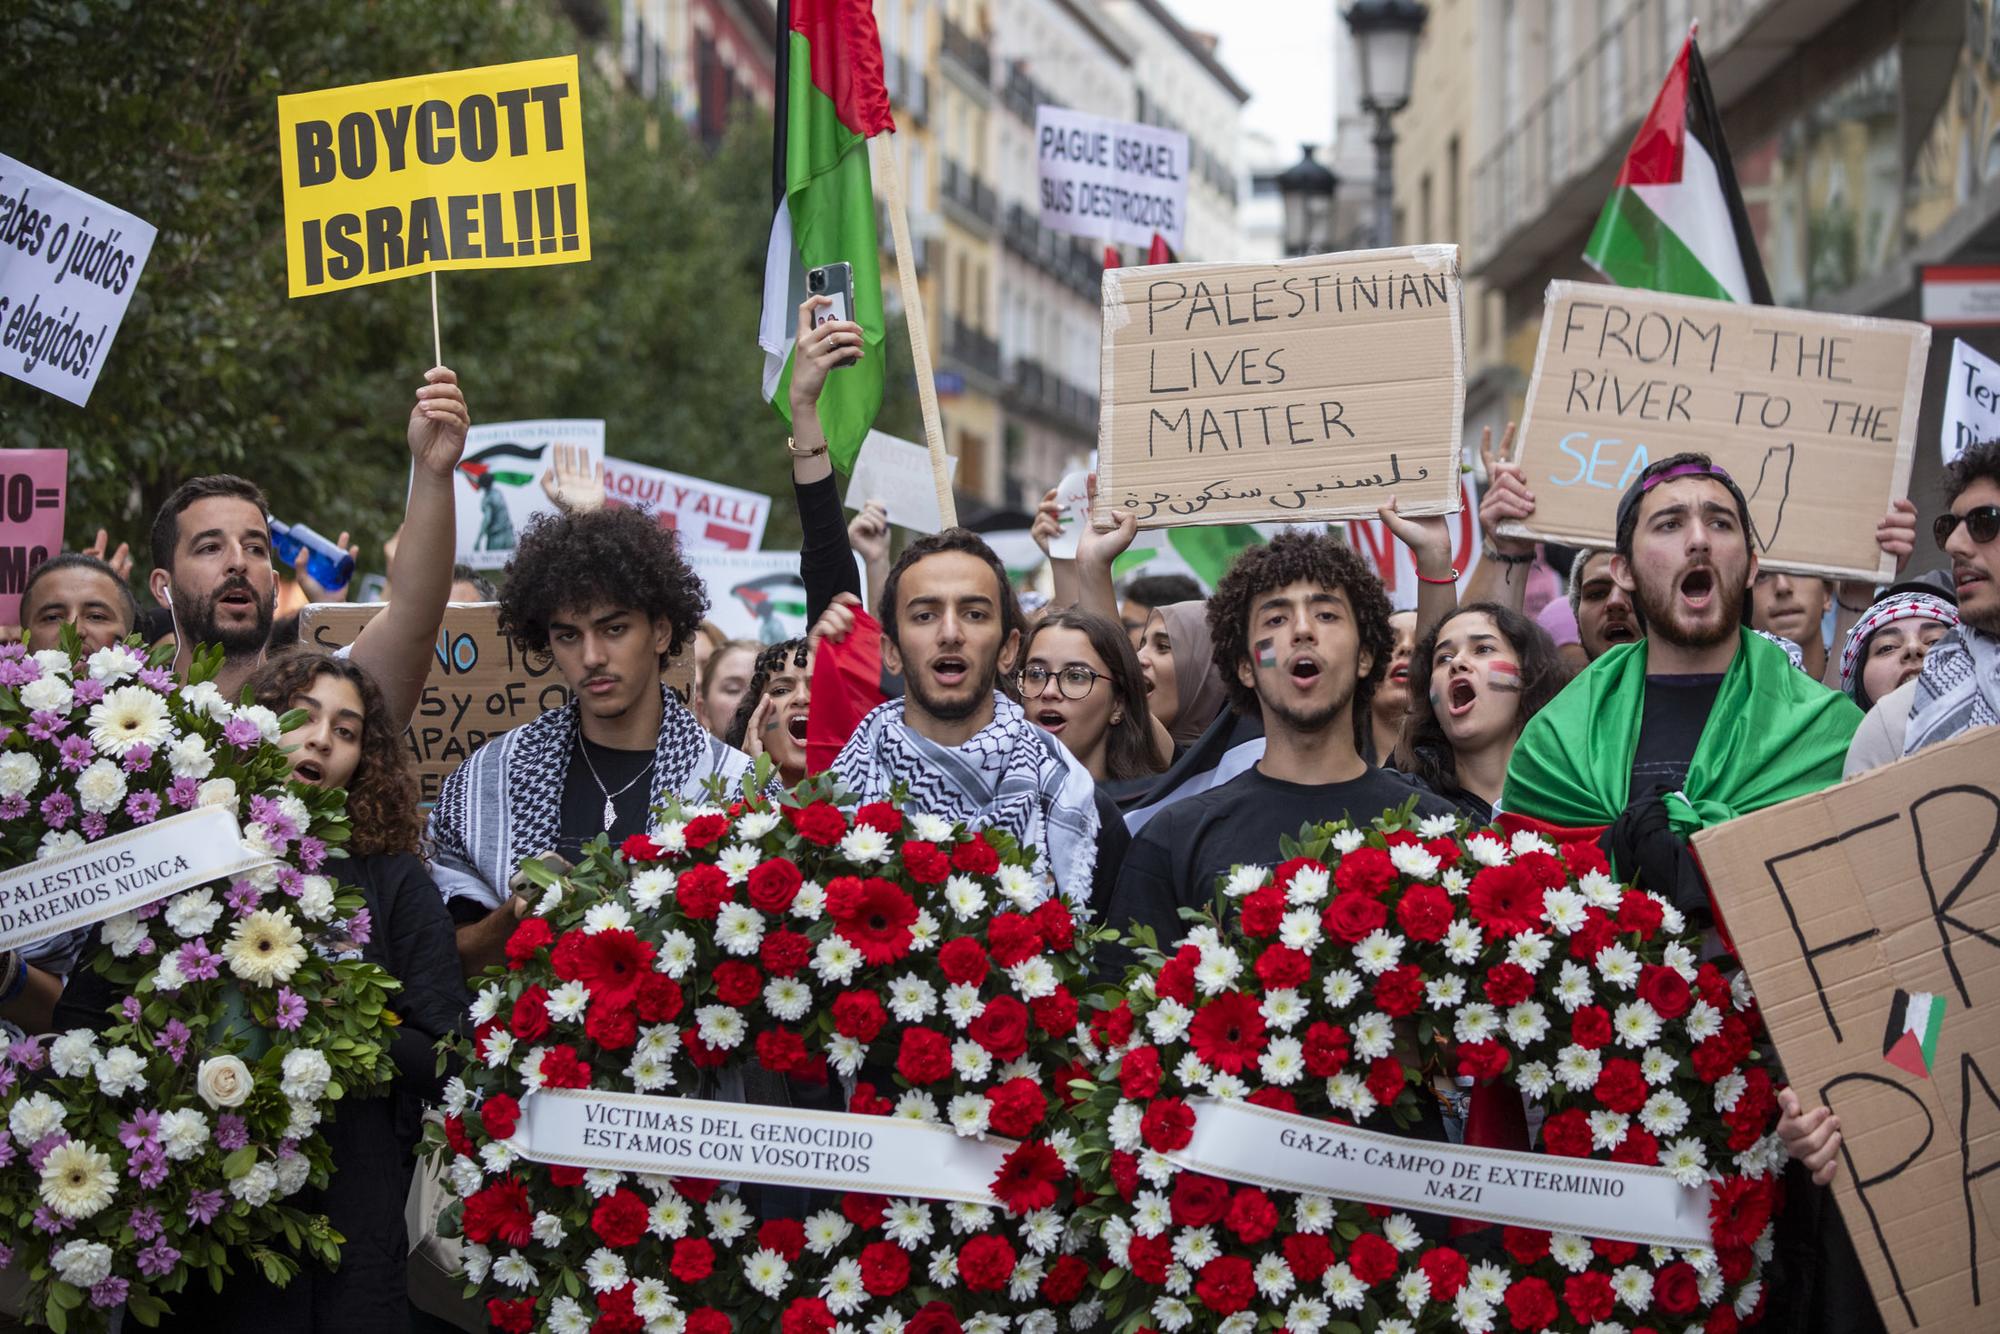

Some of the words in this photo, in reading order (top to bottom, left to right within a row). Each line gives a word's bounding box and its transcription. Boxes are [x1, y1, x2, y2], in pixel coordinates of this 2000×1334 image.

[295, 83, 569, 188] BOYCOTT
[1041, 125, 1108, 168] PAGUE
[1113, 137, 1180, 182] ISRAEL
[1041, 176, 1074, 215] SUS
[47, 222, 70, 264] o
[54, 216, 135, 295] judíos
[302, 183, 580, 287] ISRAEL!!!
[1148, 270, 1449, 336] PALESTINIAN
[3, 293, 107, 380] elegidos!
[1562, 302, 1721, 373] FROM
[1752, 328, 1853, 384] THE
[1150, 348, 1286, 394] LIVES
[1149, 401, 1356, 458] MATTER
[1566, 368, 1692, 422] RIVER
[1733, 390, 1791, 429] TO
[1822, 399, 1899, 442] THE
[1548, 431, 1649, 490] SEA
[603, 470, 664, 503] AQUÍ
[673, 487, 690, 509] Y
[693, 493, 757, 527] ALLÍ
[0, 850, 136, 910] PALESTINOS
[0, 882, 111, 933] DAREMOS
[114, 854, 191, 896] NUNCA
[583, 1128, 693, 1158] ESTAMOS
[698, 1140, 744, 1163] CON
[750, 1144, 871, 1174] VOSOTROS
[700, 1116, 744, 1139] DEL
[750, 1122, 873, 1151] GENOCIDIO
[1279, 1128, 1356, 1162] GAZA:
[1363, 1147, 1445, 1177] CAMPO
[1450, 1161, 1481, 1182] DE
[1487, 1165, 1624, 1199] EXTERMINIO
[1423, 1179, 1483, 1204] NAZI
